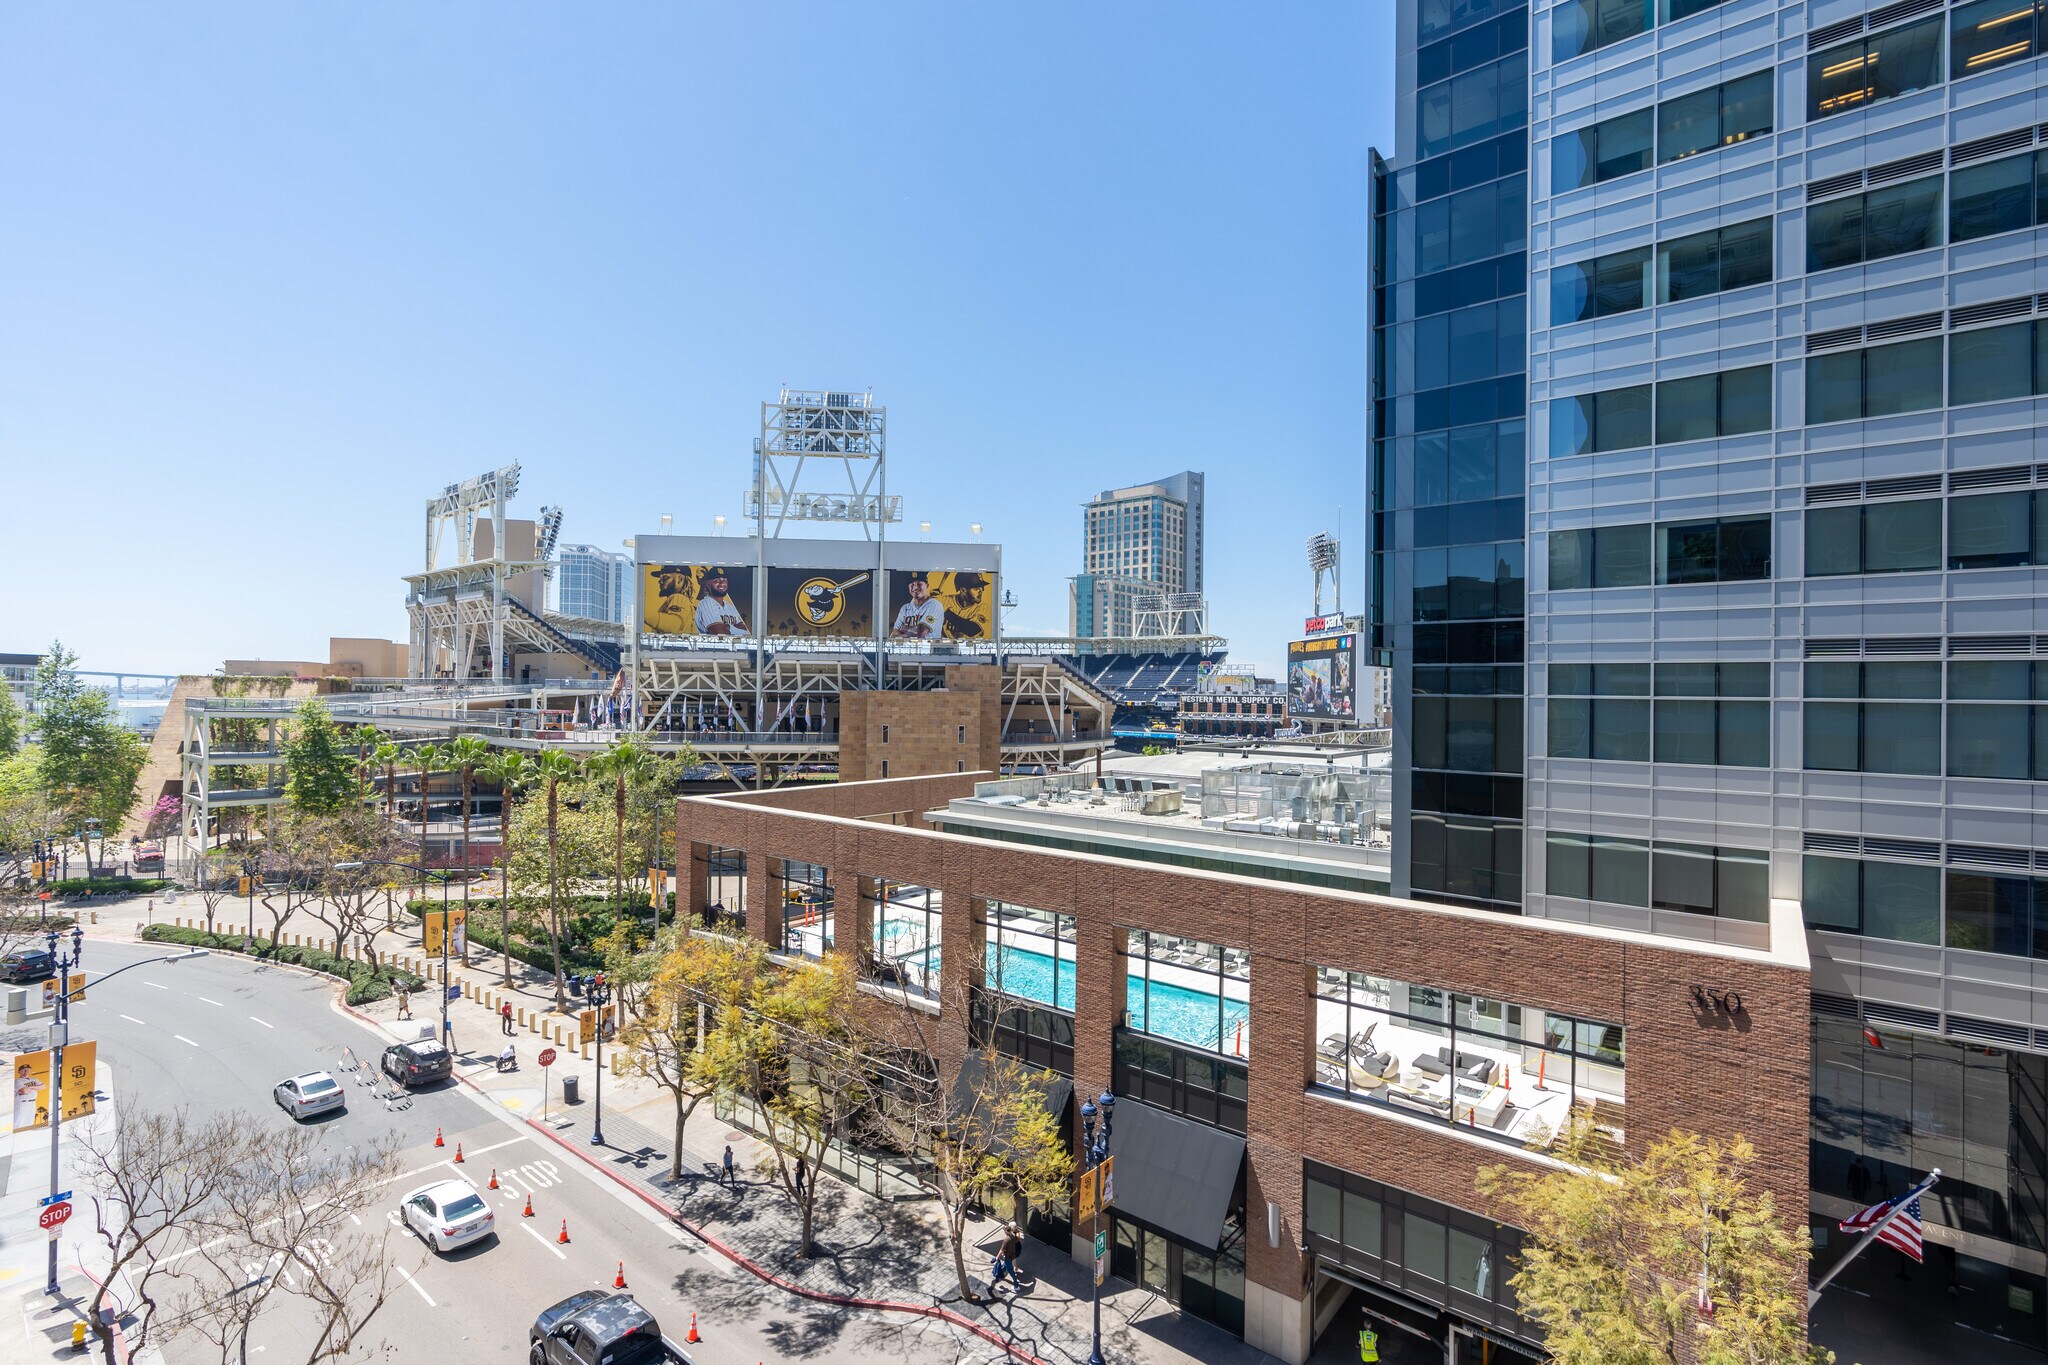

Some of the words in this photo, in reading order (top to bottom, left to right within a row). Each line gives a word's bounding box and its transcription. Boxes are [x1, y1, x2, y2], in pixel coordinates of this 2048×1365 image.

[1305, 617, 1325, 634] petco
[1325, 613, 1343, 632] park
[1181, 695, 1214, 703] WESTERN
[1216, 696, 1240, 704] METAL
[1241, 696, 1270, 704] SUPPLY
[1272, 696, 1287, 704] CO.
[1688, 984, 1741, 1015] 350
[539, 1052, 556, 1063] STOP
[488, 1160, 563, 1200] STOP
[41, 1206, 71, 1225] STOP
[1924, 1224, 1977, 1246] AVENUE
